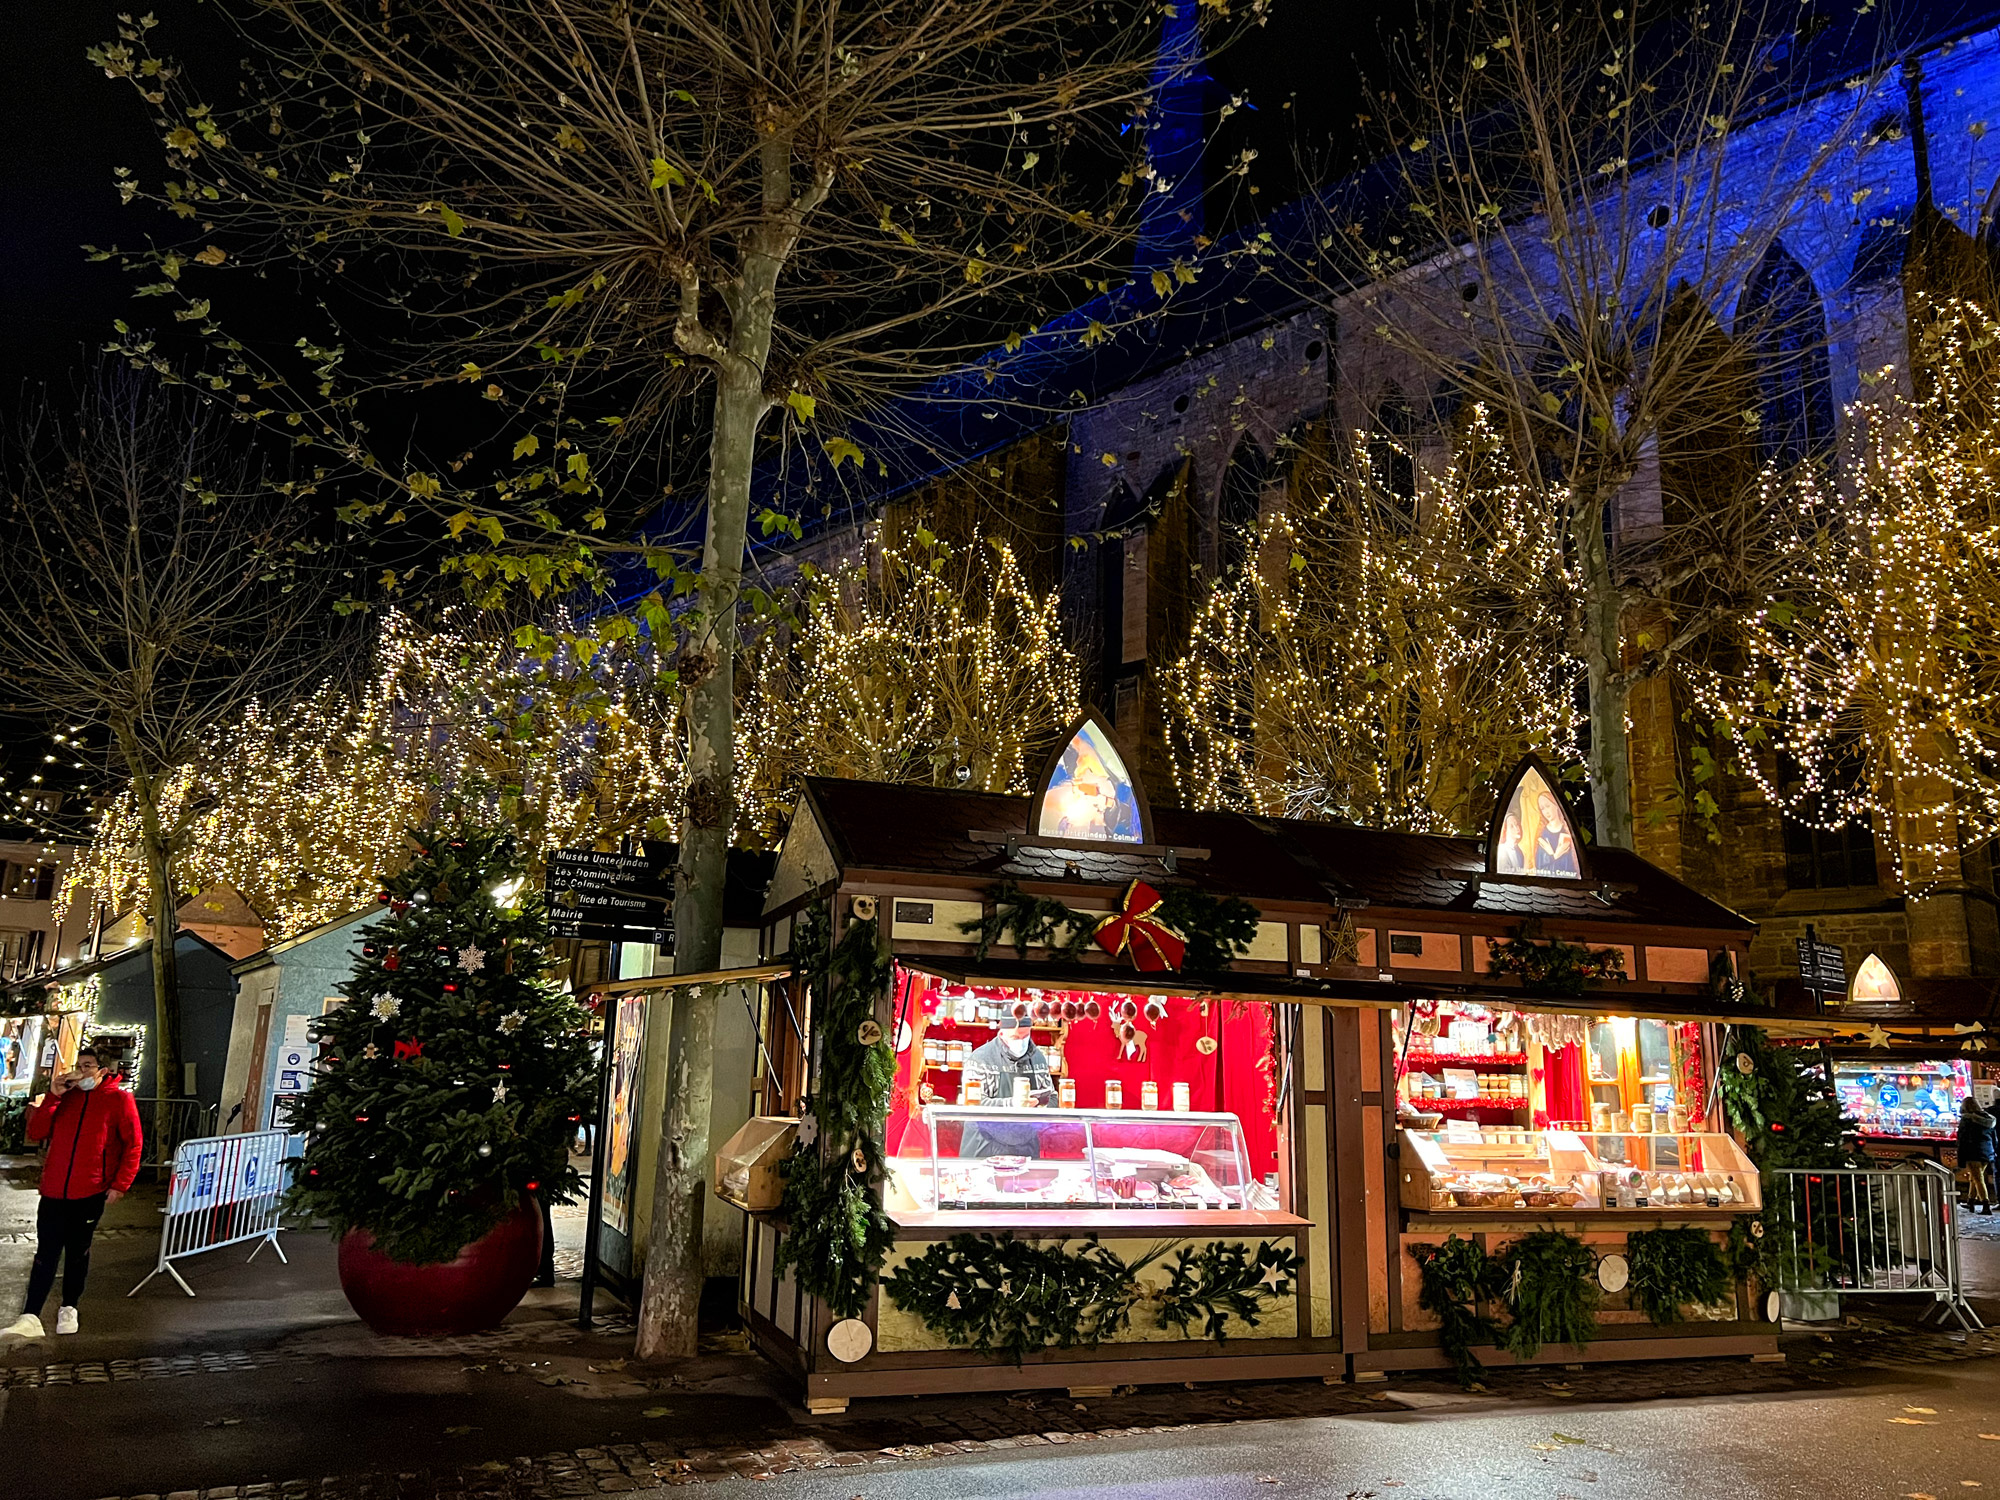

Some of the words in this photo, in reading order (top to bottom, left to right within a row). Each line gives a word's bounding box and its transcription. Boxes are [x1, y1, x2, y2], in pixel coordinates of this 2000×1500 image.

[1113, 834, 1138, 842] Colmar
[556, 850, 589, 862] Musée
[592, 854, 649, 867] Unterlinden
[555, 866, 572, 876] Les
[598, 896, 608, 904] de
[610, 897, 646, 908] Tourisme
[551, 908, 583, 919] Mairie
